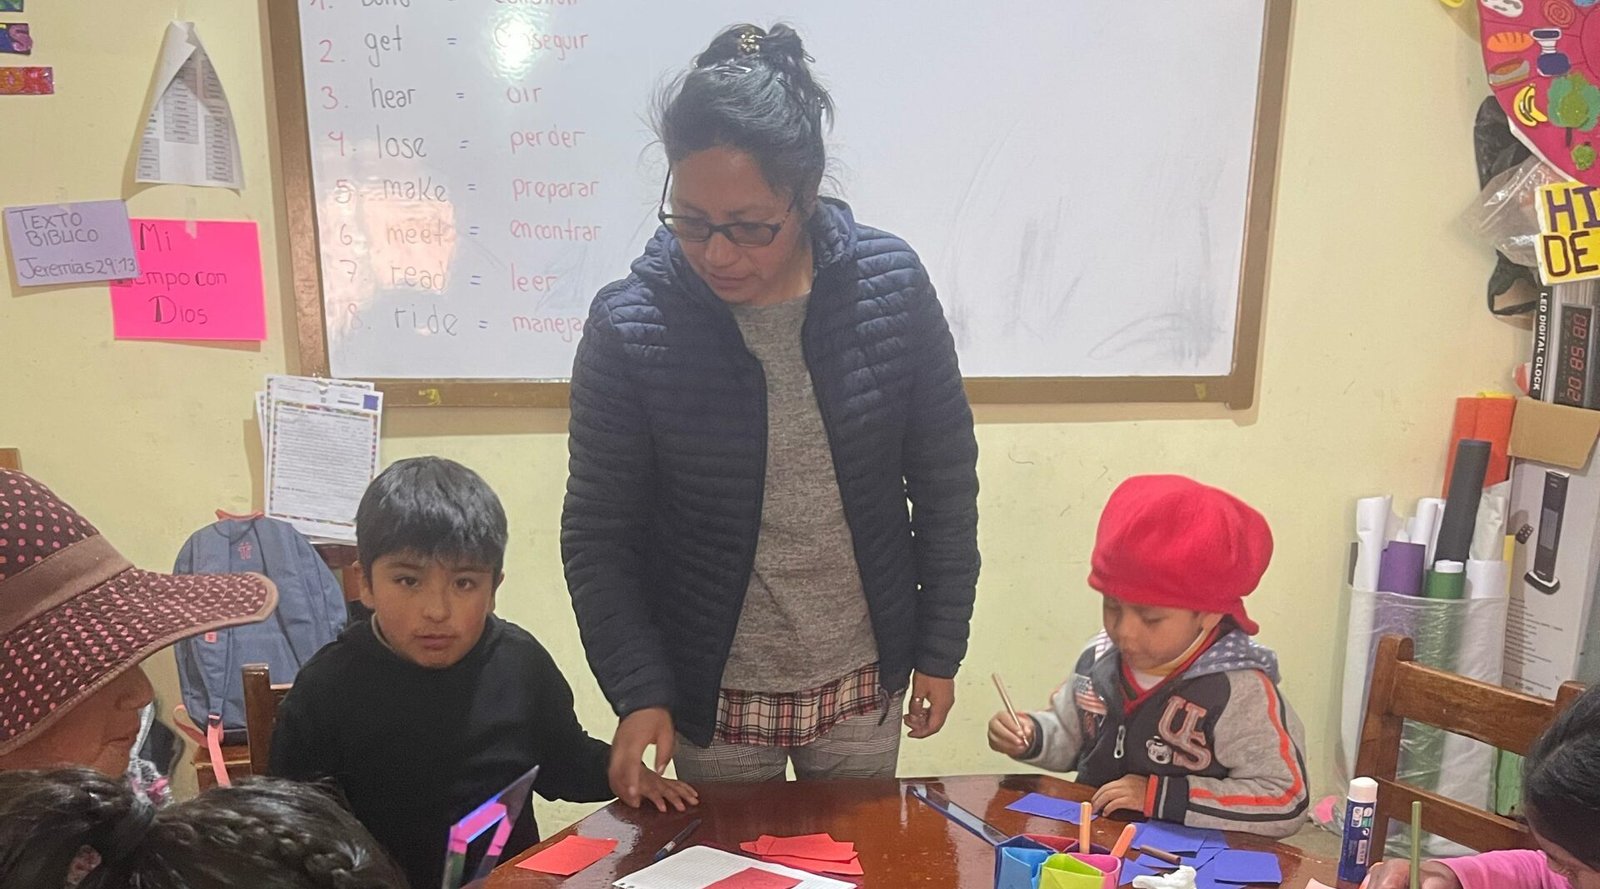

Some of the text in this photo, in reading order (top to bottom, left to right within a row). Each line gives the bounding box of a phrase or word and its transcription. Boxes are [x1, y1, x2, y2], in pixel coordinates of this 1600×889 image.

[364, 25, 402, 67] get
[321, 86, 349, 110] 3.
[369, 78, 416, 109] hear
[506, 86, 543, 104] oir
[376, 124, 427, 159] lose
[510, 124, 586, 154] perder
[383, 176, 447, 203] make
[512, 178, 600, 204] preparar
[9, 208, 82, 230] TEXTO
[387, 218, 447, 247] meet
[510, 218, 603, 241] encontrar
[25, 229, 99, 247] BIBLICO
[140, 222, 171, 252] Mi
[1543, 231, 1599, 278] DE
[391, 260, 448, 292] read
[511, 263, 557, 292] leer
[148, 295, 208, 325] Dios
[394, 304, 458, 336] ride
[1532, 292, 1549, 391] LED DIGITAL CLOCK
[1158, 695, 1212, 771] US
